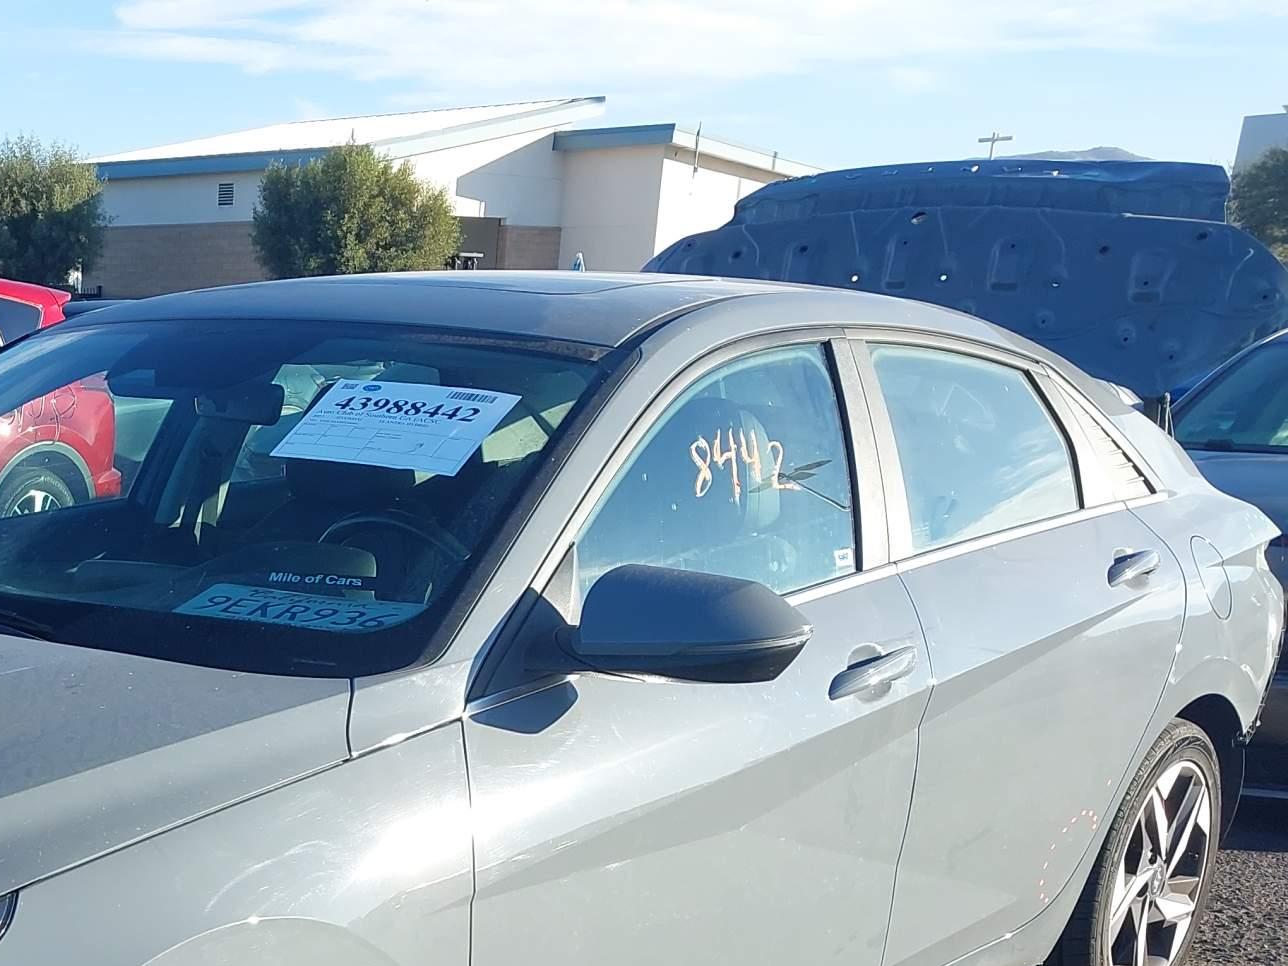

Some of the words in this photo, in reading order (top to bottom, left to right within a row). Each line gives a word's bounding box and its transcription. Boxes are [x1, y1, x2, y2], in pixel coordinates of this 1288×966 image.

[334, 395, 481, 422] 43988442
[689, 427, 802, 505] 8442
[268, 571, 301, 584] Mile
[304, 573, 323, 584] of
[325, 575, 363, 587] Cars
[197, 595, 400, 628] 9EKR936
